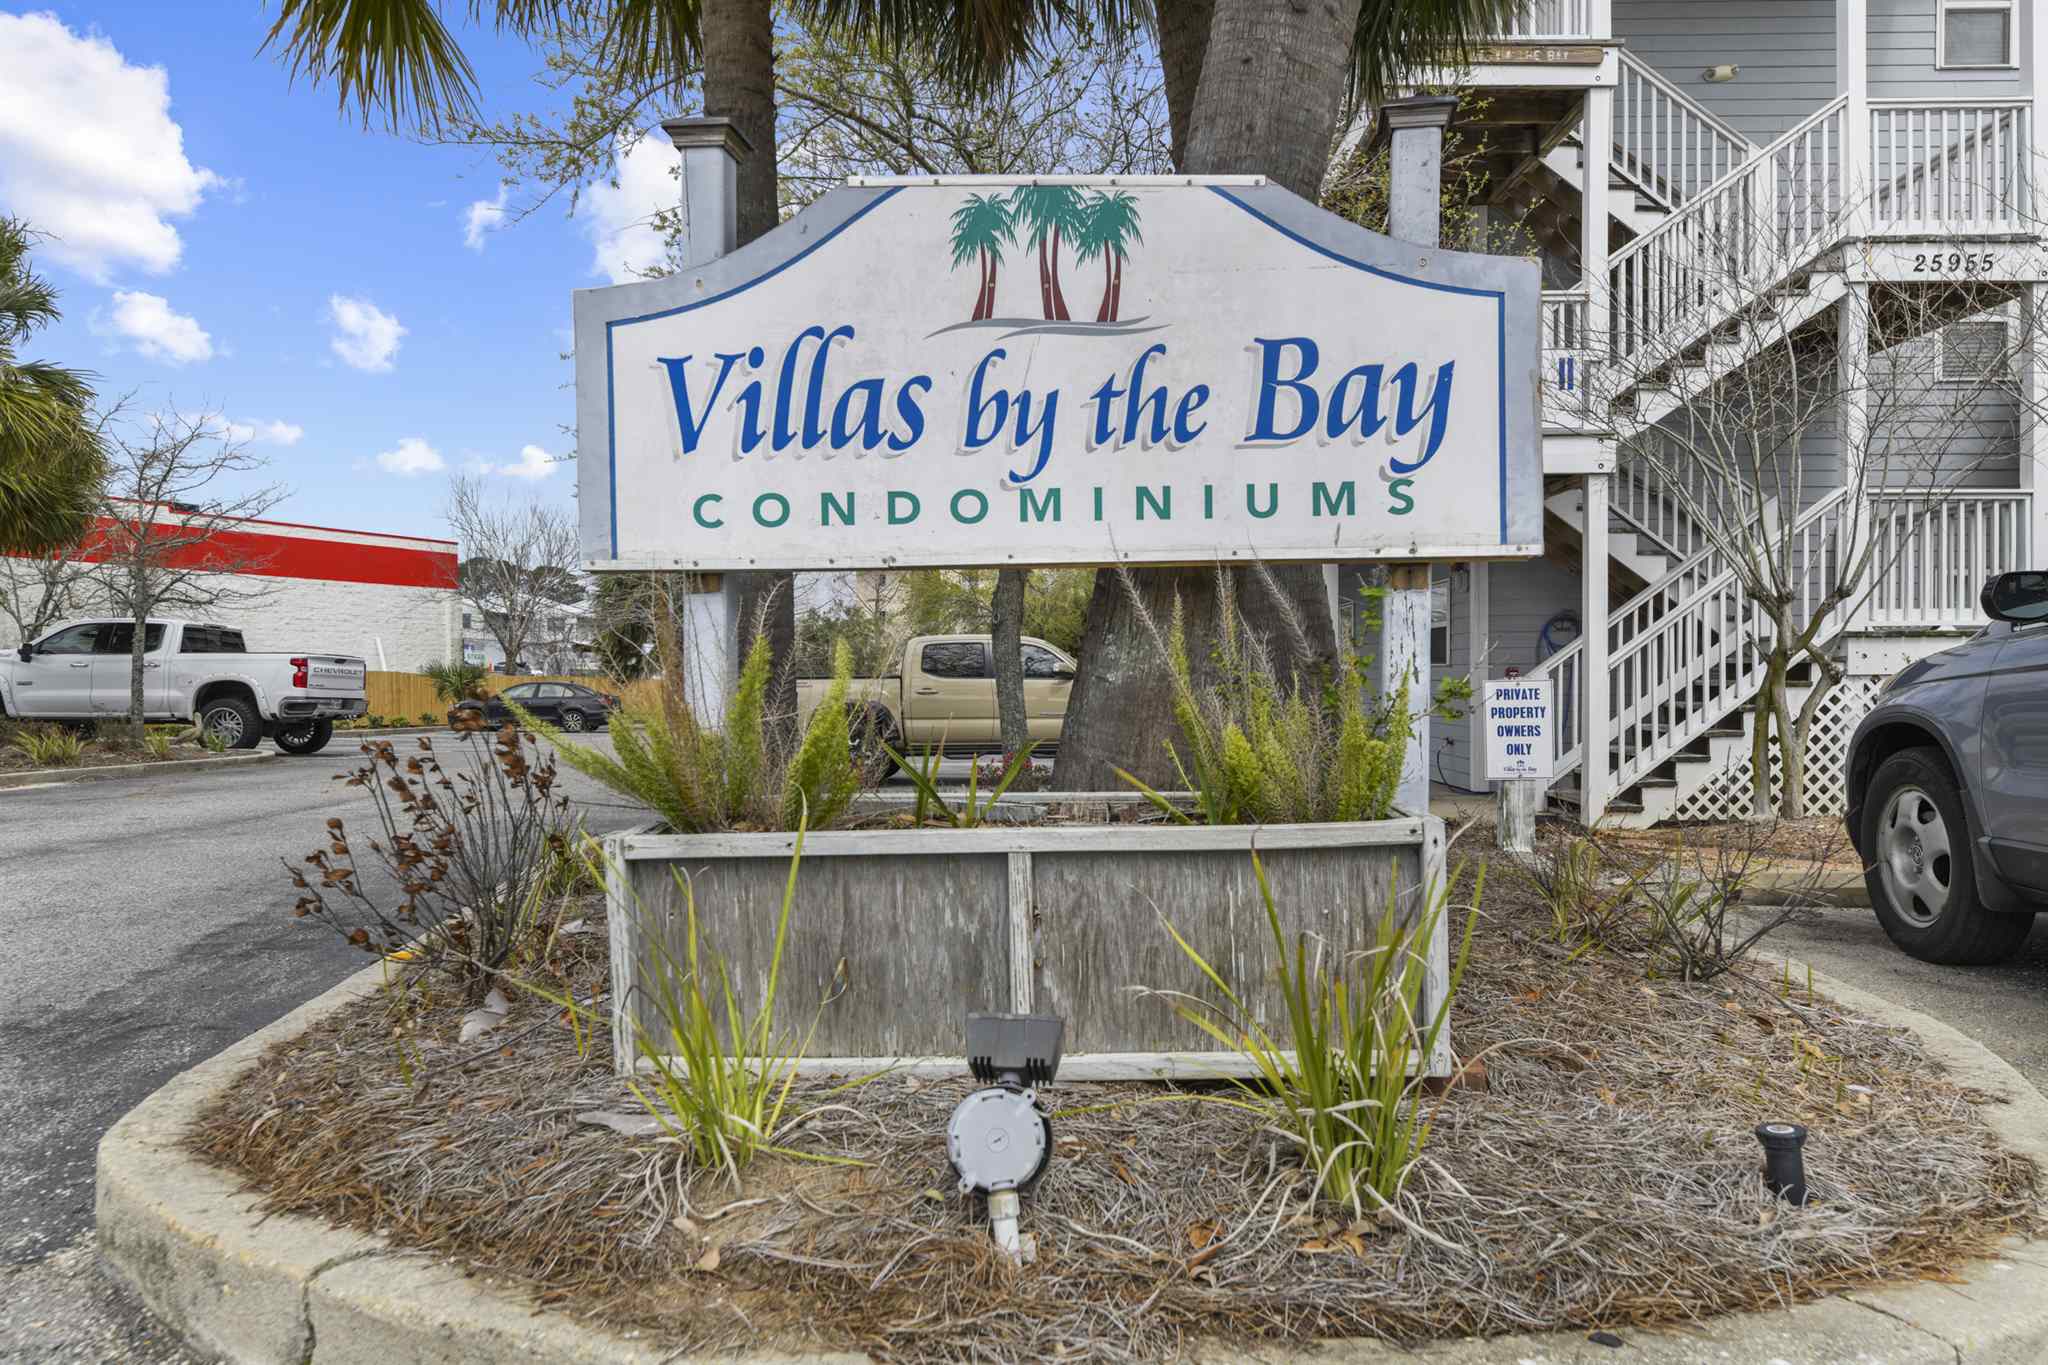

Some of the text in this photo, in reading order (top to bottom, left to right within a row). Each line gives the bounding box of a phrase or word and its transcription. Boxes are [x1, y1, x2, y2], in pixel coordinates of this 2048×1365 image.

[1913, 253, 1994, 273] 25955
[656, 325, 1455, 483] Villas by the Bay
[693, 479, 1415, 528] CONDOMINIUMS
[313, 666, 363, 675] CHEVROLET
[1496, 688, 1541, 700] PRIVATE
[1491, 707, 1546, 719] PROPERTY
[1497, 725, 1541, 737] OWNERS
[1506, 743, 1532, 755] ONLY
